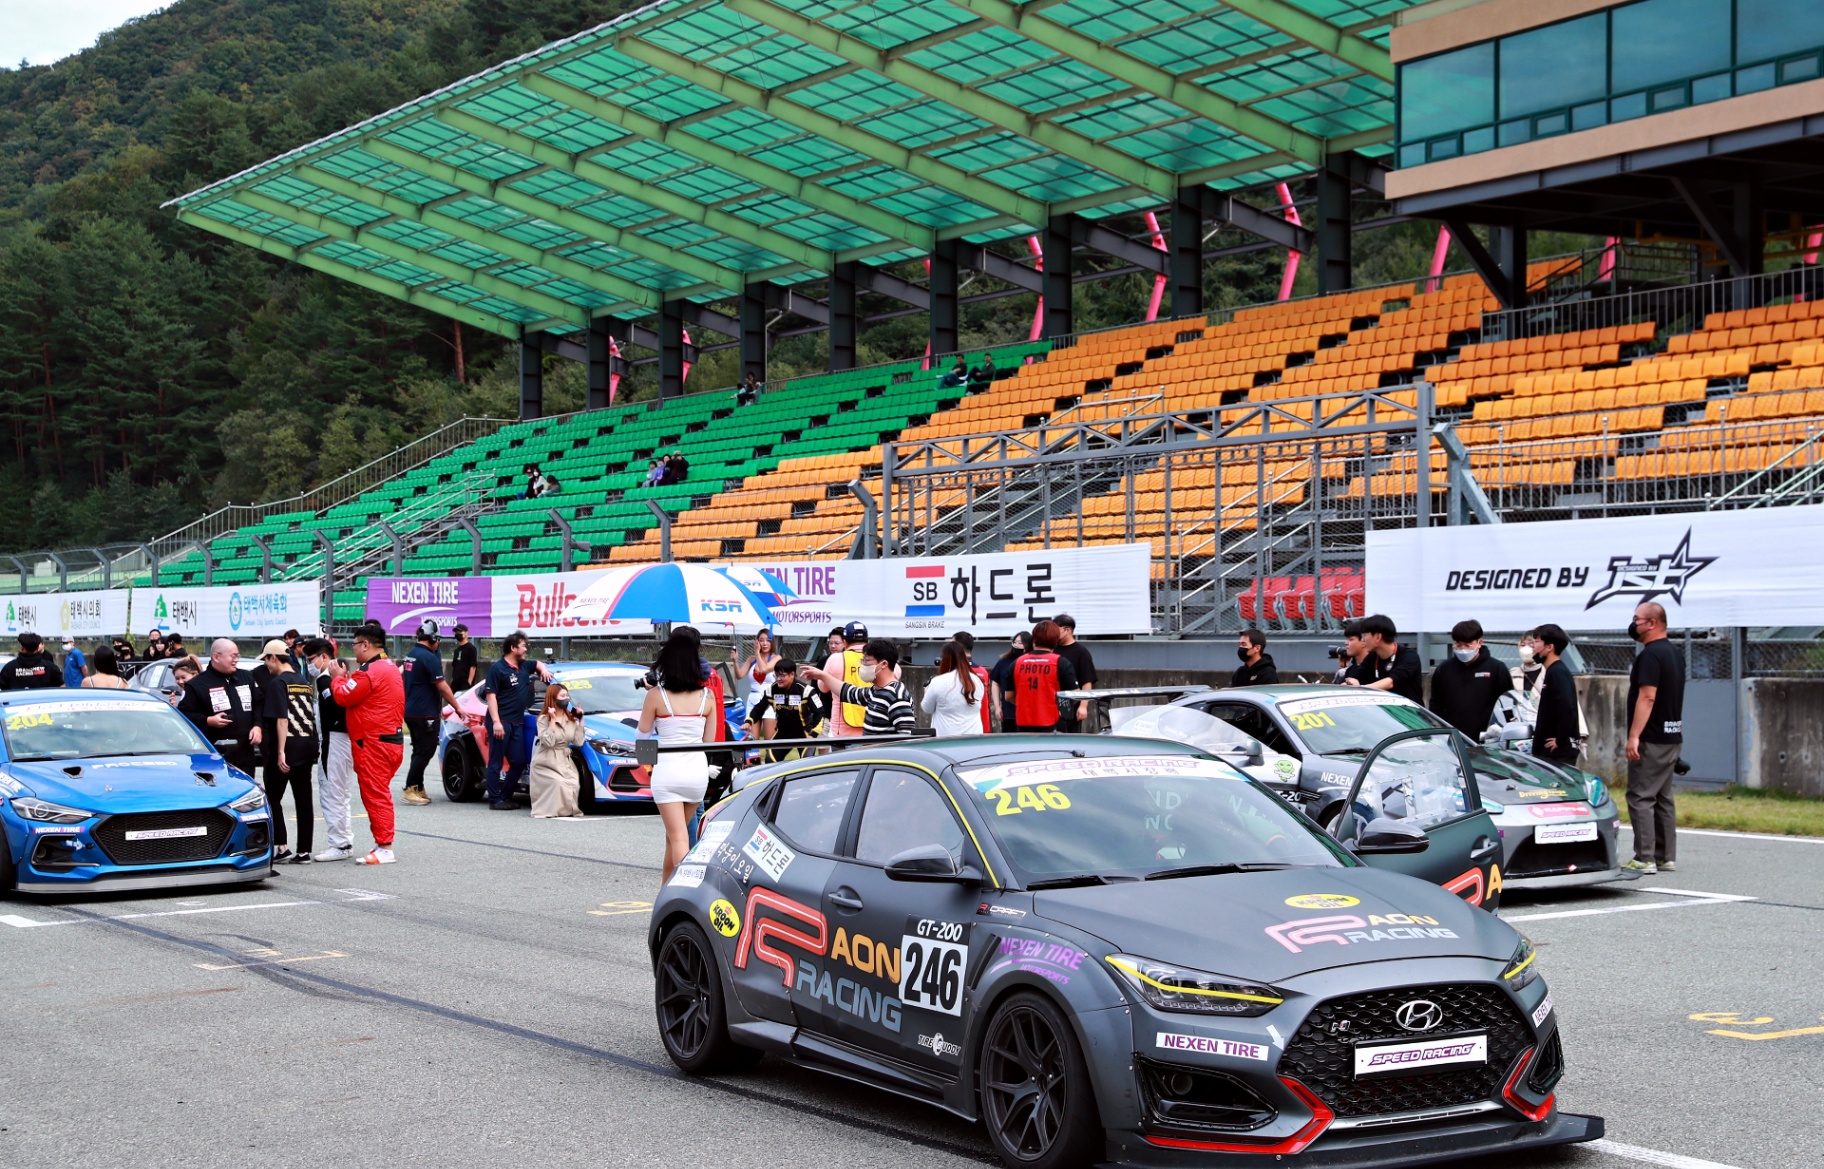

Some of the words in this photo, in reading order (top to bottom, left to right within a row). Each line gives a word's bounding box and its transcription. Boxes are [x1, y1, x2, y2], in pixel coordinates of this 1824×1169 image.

[793, 566, 836, 596] TIRE
[1446, 567, 1552, 590] DESIGNED
[1556, 566, 1590, 587] BY
[391, 581, 430, 604] NEXEN
[431, 581, 459, 604] TIRE
[913, 581, 938, 602] SB
[950, 563, 1056, 626] 하드론
[70, 598, 102, 621] 태백시의회
[172, 600, 198, 630] 태백시
[243, 592, 288, 616] 태백시체육회
[700, 599, 743, 613] KSR
[19, 604, 37, 630] 태백시
[904, 621, 927, 629] SANGSIN
[927, 620, 945, 629] BRAKE
[1020, 664, 1051, 675] PHOTO
[1028, 677, 1039, 691] 14
[6, 713, 54, 730] 204
[1290, 711, 1337, 732] 201
[91, 760, 178, 771] PROCEED
[1005, 761, 1101, 778] SPEED
[1320, 771, 1354, 788] NEXEN
[985, 784, 1072, 816] 246
[35, 826, 62, 834] NEXEN
[135, 831, 167, 840] SPEED
[755, 836, 764, 845] SB
[762, 840, 791, 876] 하드론
[713, 904, 736, 931] KROON
[714, 917, 724, 932] OIL
[917, 919, 964, 942] GT-200
[1343, 927, 1461, 944] RACING
[1000, 937, 1046, 958] NEXEN
[1044, 944, 1086, 971] TIRE
[904, 942, 963, 1012] 246
[1020, 963, 1071, 985] MOTORSPORTS
[797, 959, 903, 1034] RACING
[1163, 1033, 1221, 1054] NEXEN
[1223, 1040, 1261, 1059] TIRE
[1368, 1049, 1421, 1067] SPEED
[1422, 1042, 1477, 1061] RACING
